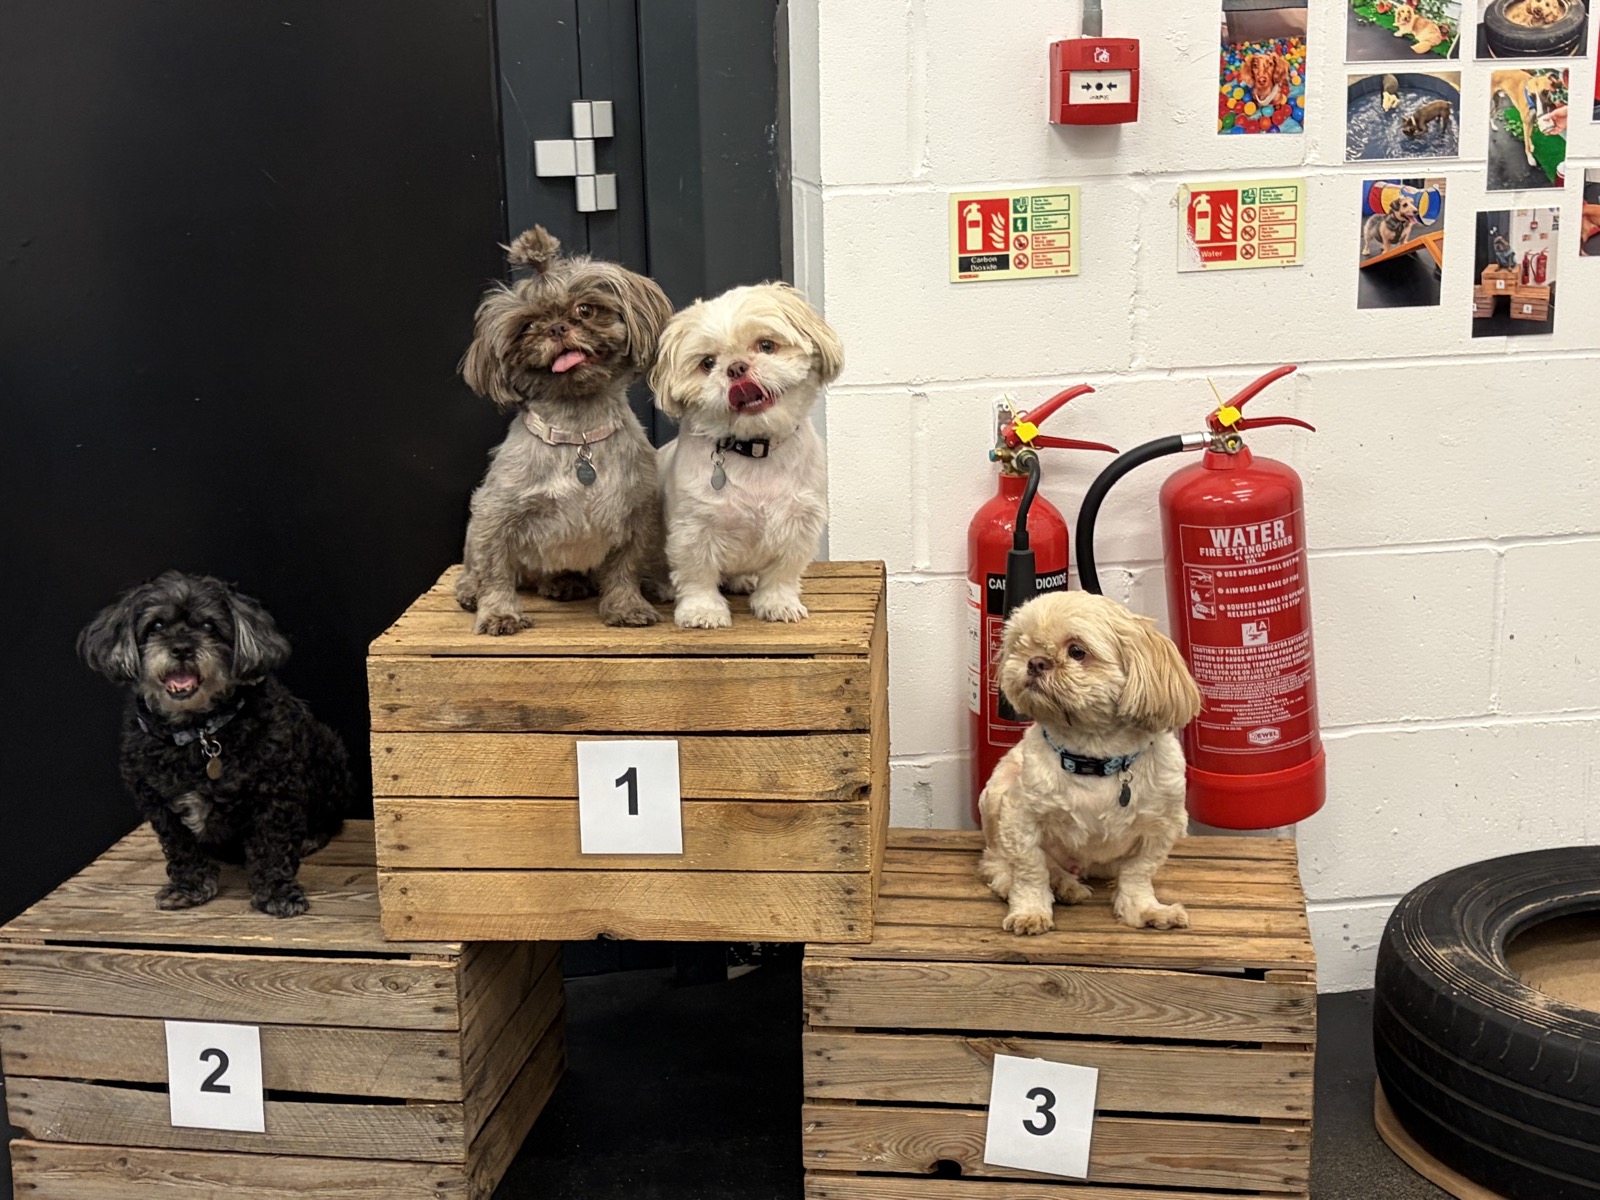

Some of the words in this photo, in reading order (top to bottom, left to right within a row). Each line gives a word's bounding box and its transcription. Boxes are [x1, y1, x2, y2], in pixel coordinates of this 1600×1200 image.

[970, 256, 998, 264] Carbon
[1209, 519, 1285, 548] WATER
[1199, 547, 1223, 557] FIRE
[1225, 535, 1293, 557] EXTINGUISHER
[1238, 566, 1267, 576] UPRIGHT
[1267, 564, 1282, 572] PULL
[1035, 573, 1067, 590] DIOXIDE
[1240, 585, 1257, 594] HOSE
[1226, 602, 1256, 610] SQUEEZE
[1257, 596, 1281, 607] HANDLE
[1227, 609, 1257, 617] RELEASE
[1257, 604, 1281, 615] HANDLE
[1258, 620, 1267, 630] A
[615, 767, 638, 815] 1
[199, 1048, 231, 1094] 2
[1022, 1087, 1057, 1136] 3
